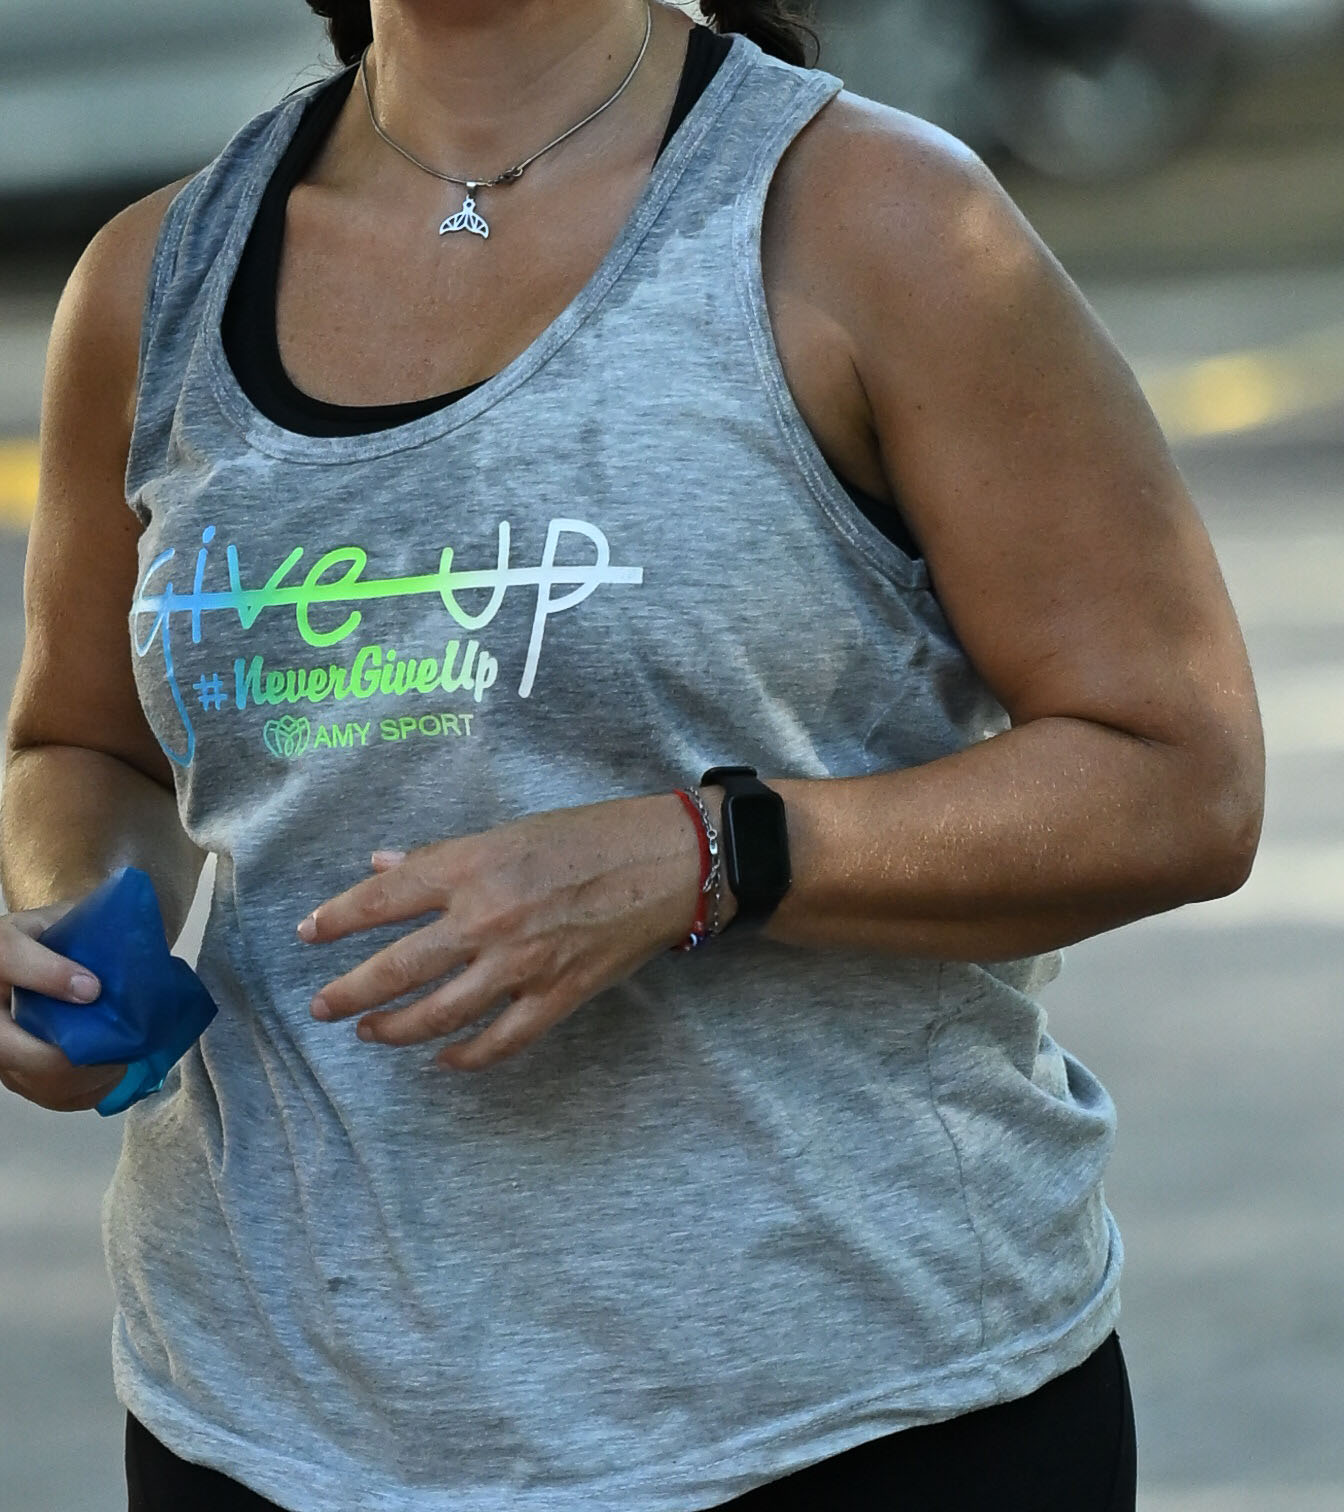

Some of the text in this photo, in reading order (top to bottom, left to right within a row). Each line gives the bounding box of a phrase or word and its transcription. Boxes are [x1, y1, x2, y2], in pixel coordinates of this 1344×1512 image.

[193, 640, 498, 712] #NeverGiveUp
[314, 714, 474, 748] AMY SPORT
